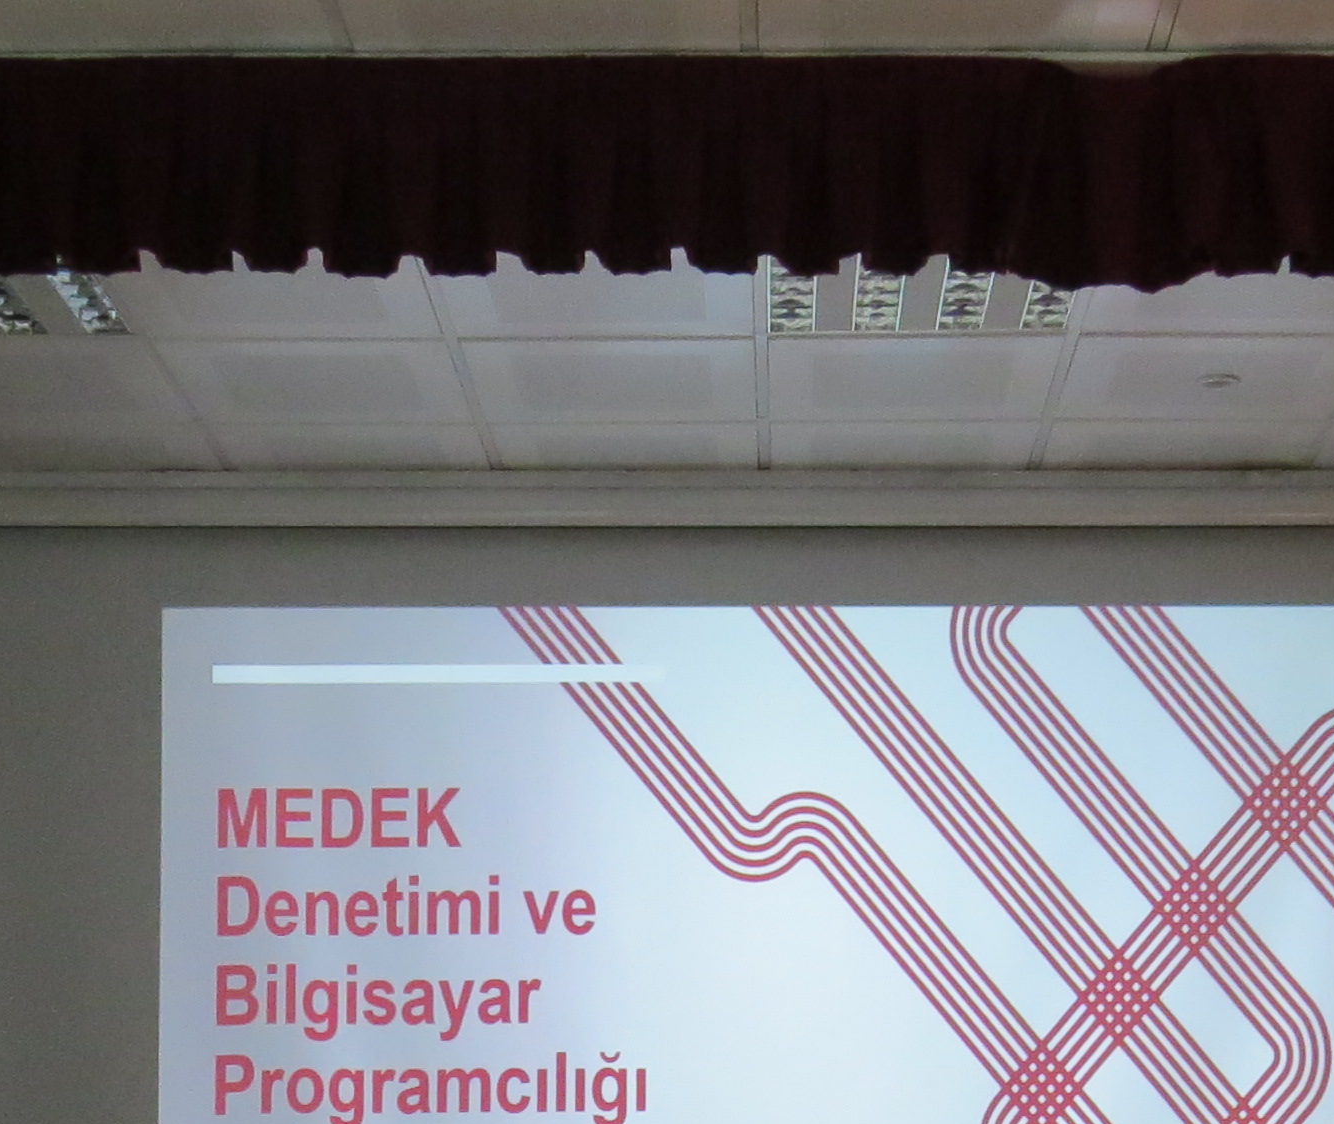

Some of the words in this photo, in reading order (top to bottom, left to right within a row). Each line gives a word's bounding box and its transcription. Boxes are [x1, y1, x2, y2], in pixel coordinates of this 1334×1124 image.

[217, 788, 461, 849] MEDEK
[216, 875, 501, 937] Denetimi
[524, 889, 597, 936] ve
[215, 963, 542, 1042] Bilgisayar
